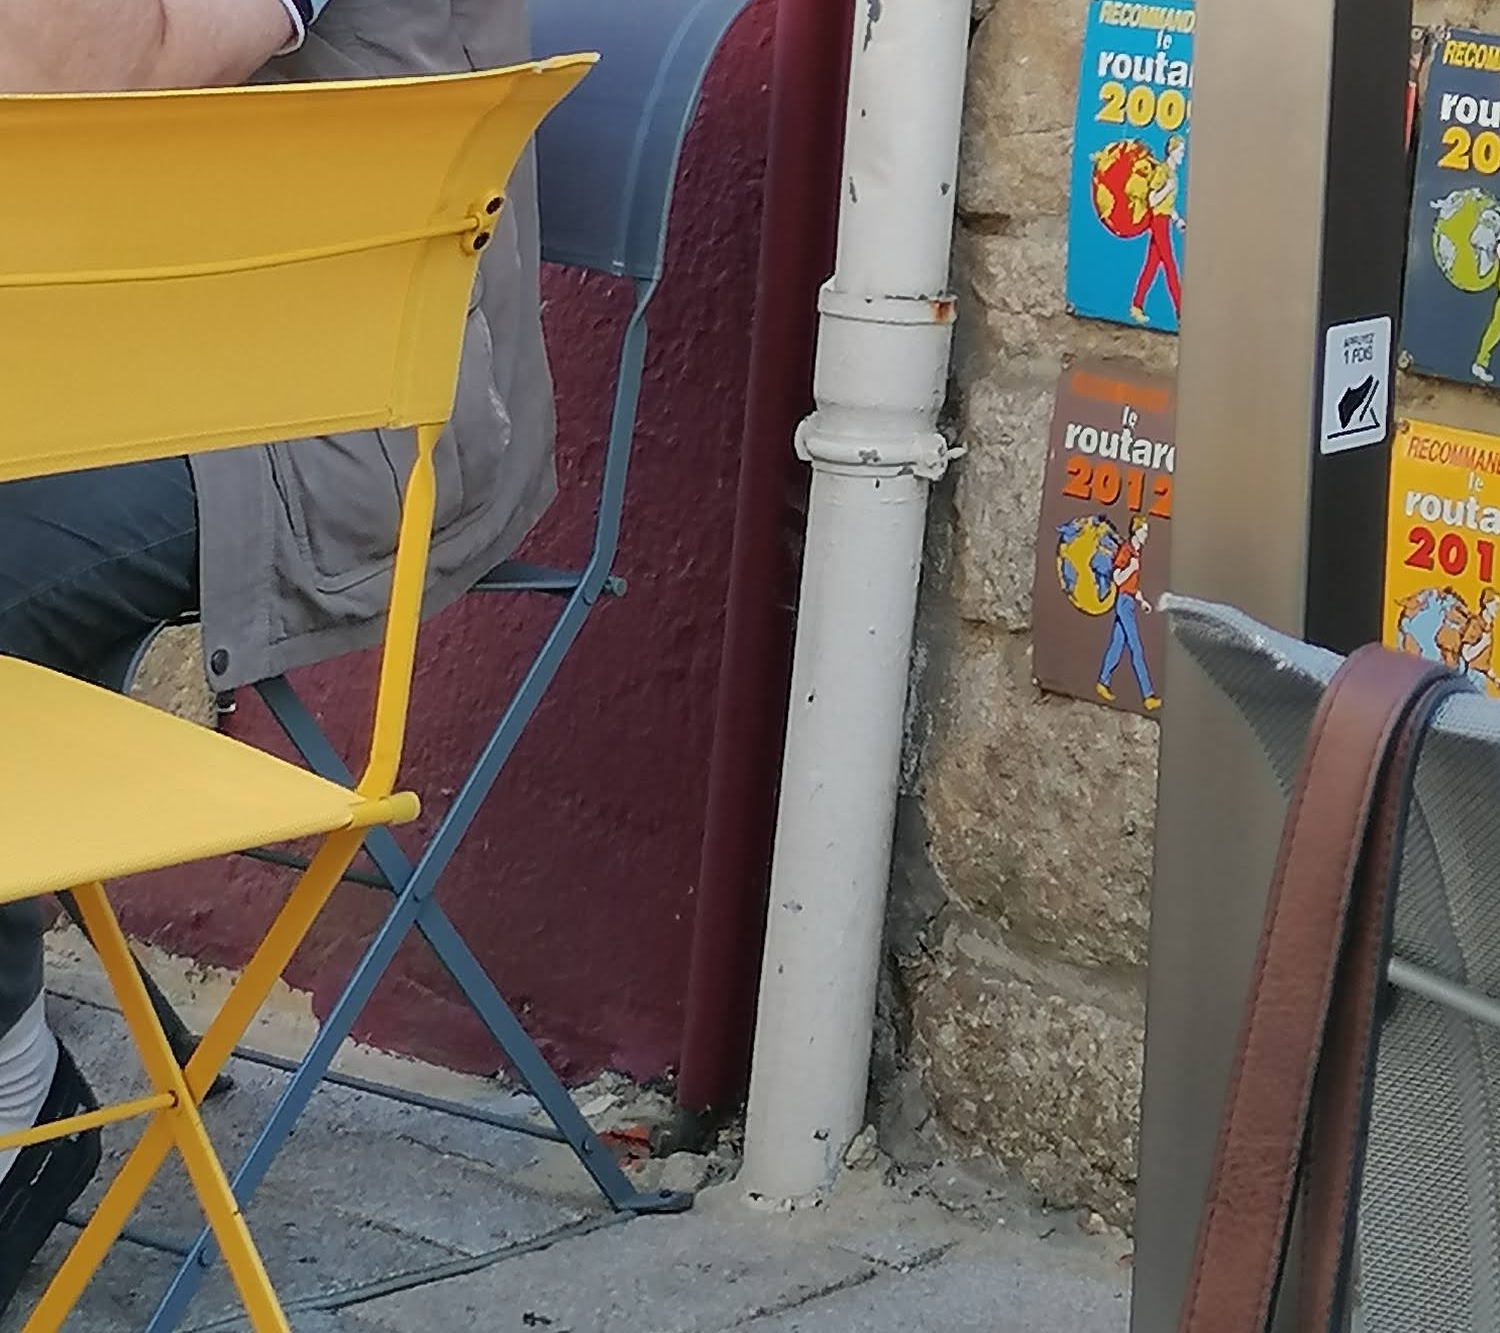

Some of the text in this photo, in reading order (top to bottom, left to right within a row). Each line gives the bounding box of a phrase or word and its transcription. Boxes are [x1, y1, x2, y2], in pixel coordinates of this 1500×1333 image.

[1156, 29, 1173, 51] le
[1094, 80, 1193, 132] 200
[1121, 405, 1139, 428] le
[1062, 454, 1173, 520] 2012
[1467, 470, 1484, 492] le
